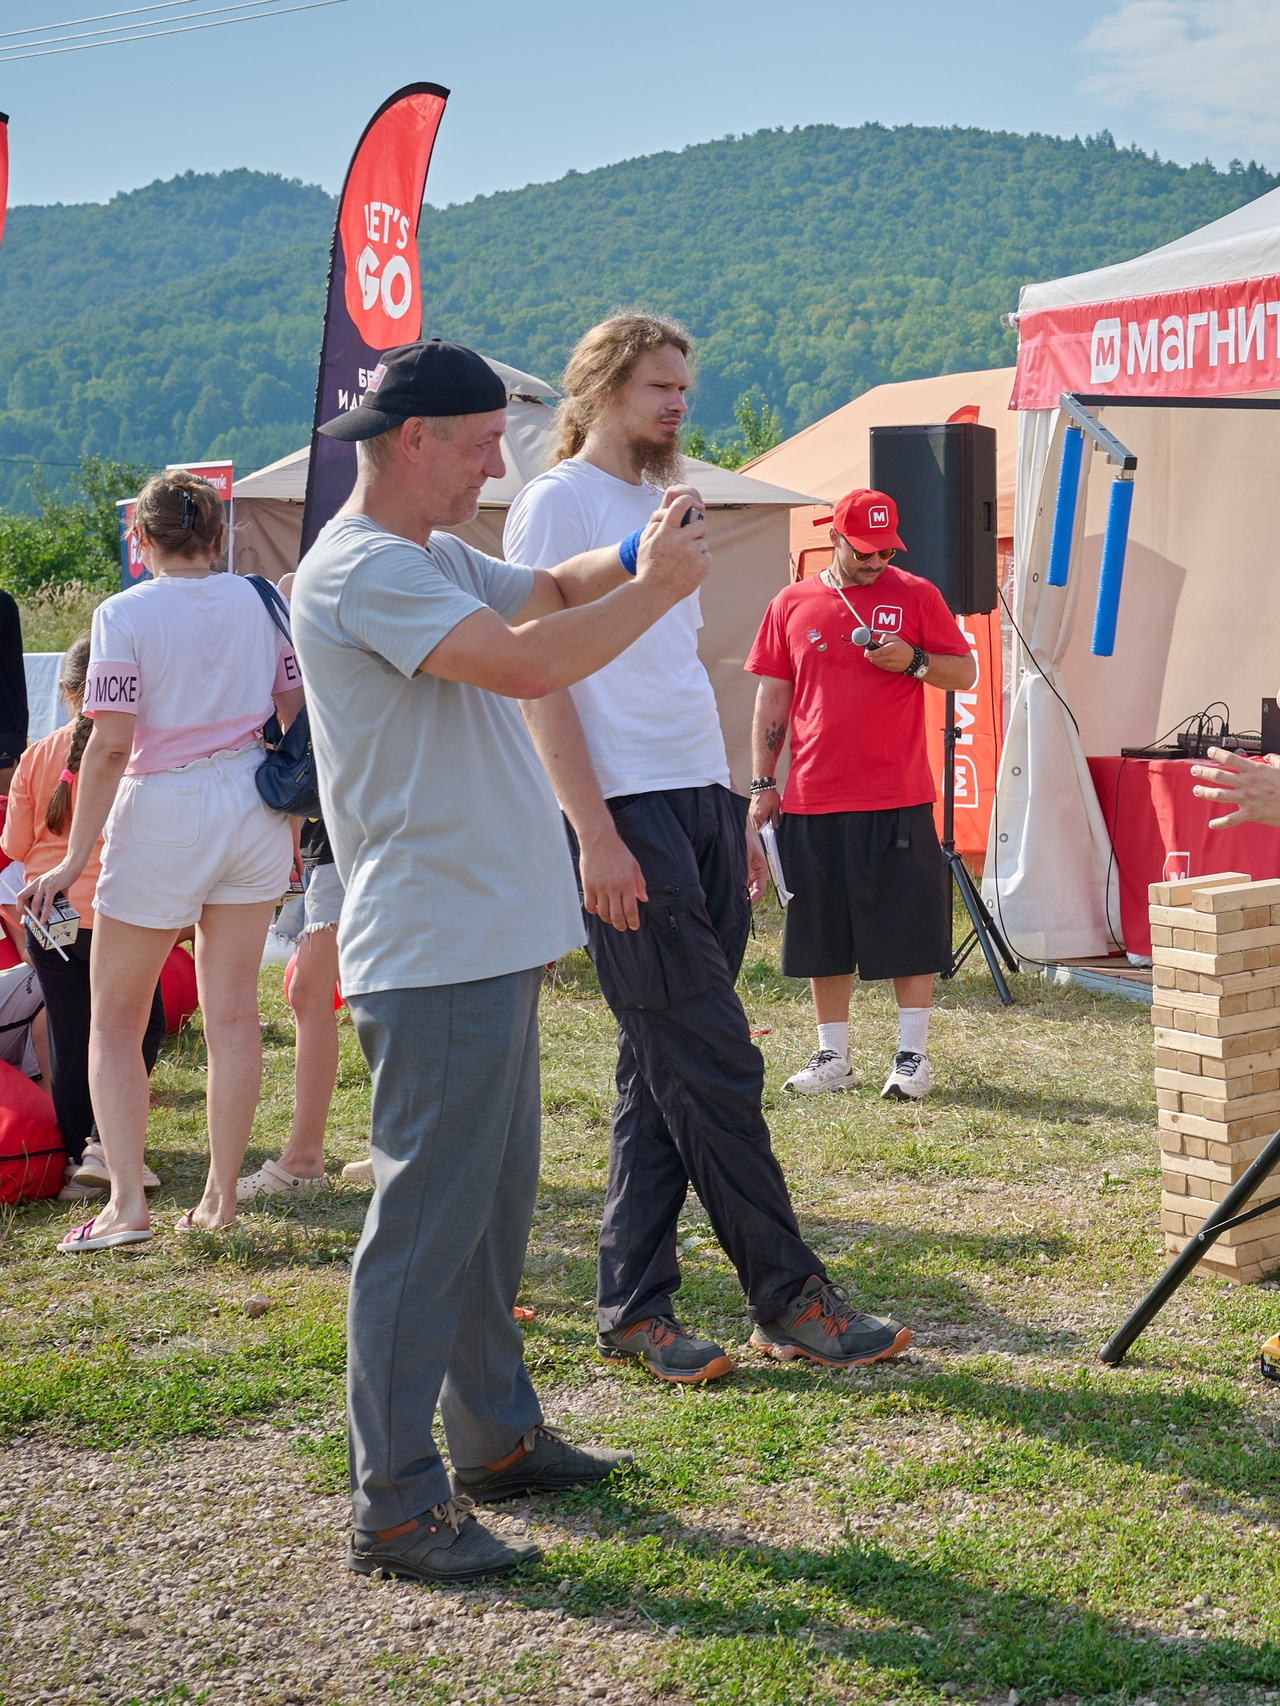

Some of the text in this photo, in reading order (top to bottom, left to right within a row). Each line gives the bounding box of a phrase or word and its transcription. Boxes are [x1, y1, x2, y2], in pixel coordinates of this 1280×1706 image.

[363, 201, 410, 250] LET'S
[357, 244, 412, 320] GO
[95, 675, 138, 703] MCKE
